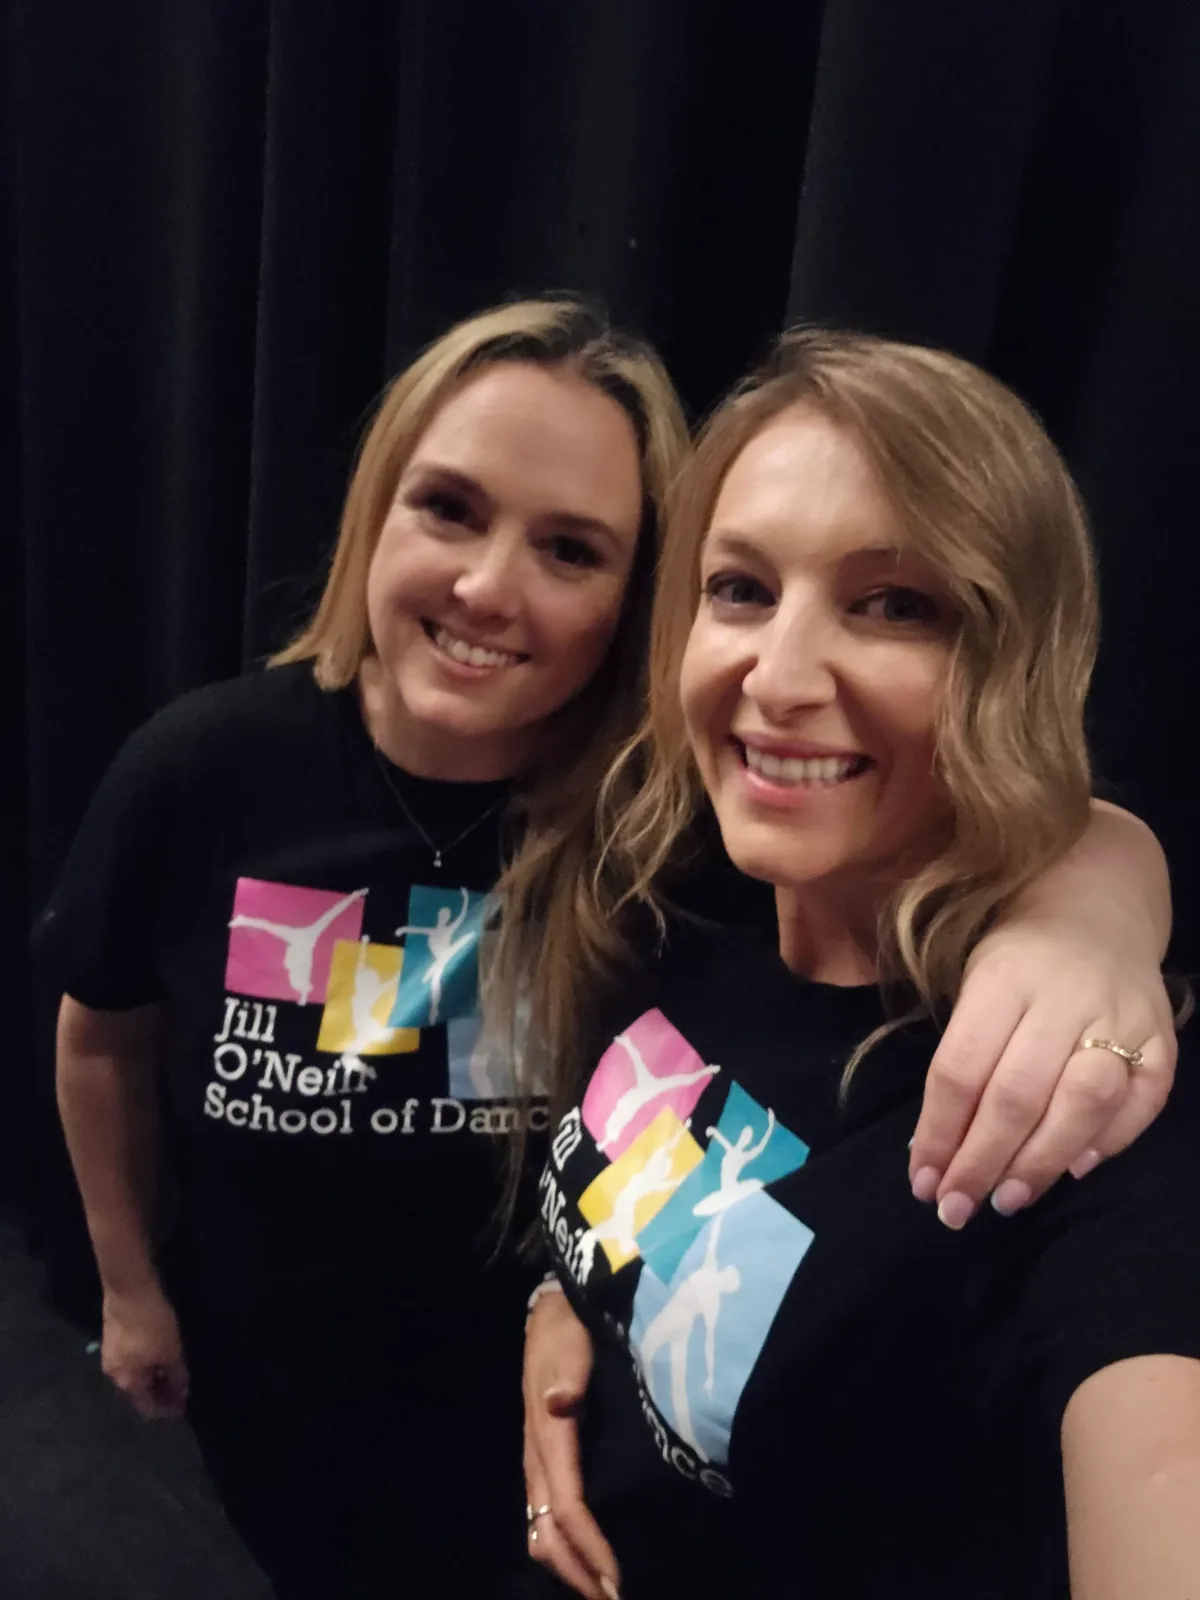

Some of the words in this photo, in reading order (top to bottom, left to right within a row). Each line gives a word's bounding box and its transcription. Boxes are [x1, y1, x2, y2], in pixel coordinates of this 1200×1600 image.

[213, 996, 277, 1043] Jill
[203, 1081, 354, 1135] School
[370, 1098, 420, 1135] of
[430, 1098, 549, 1135] Danc
